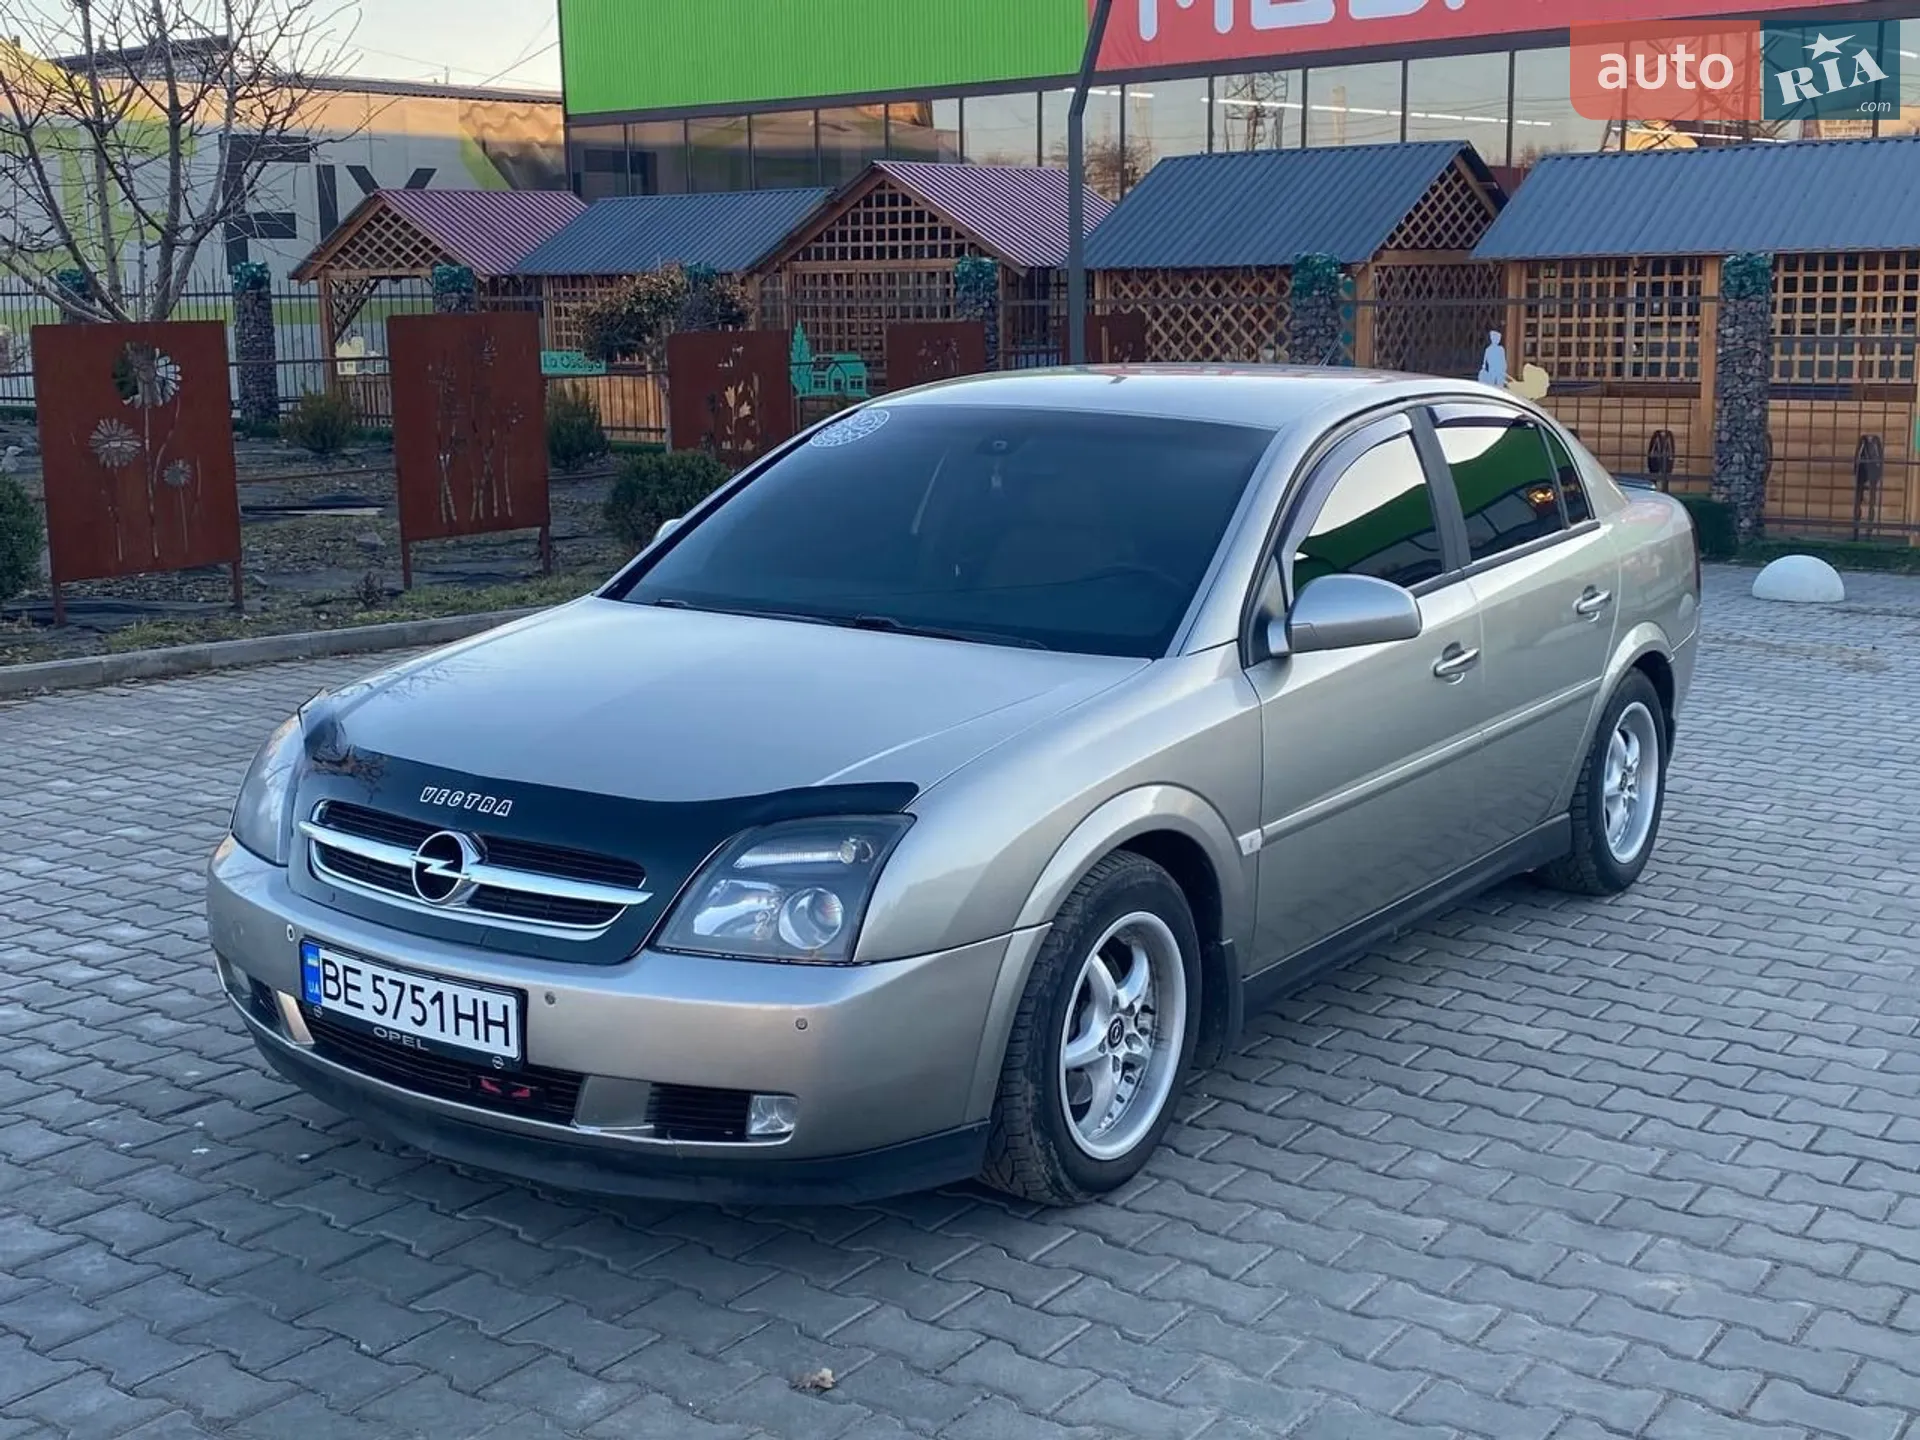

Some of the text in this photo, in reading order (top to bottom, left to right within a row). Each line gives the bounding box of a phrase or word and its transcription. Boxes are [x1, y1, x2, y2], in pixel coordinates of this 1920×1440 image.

[420, 786, 512, 817] VECTRA
[308, 981, 321, 996] UA
[321, 957, 510, 1047] BE 5751 HH
[373, 1025, 430, 1051] OPEL
